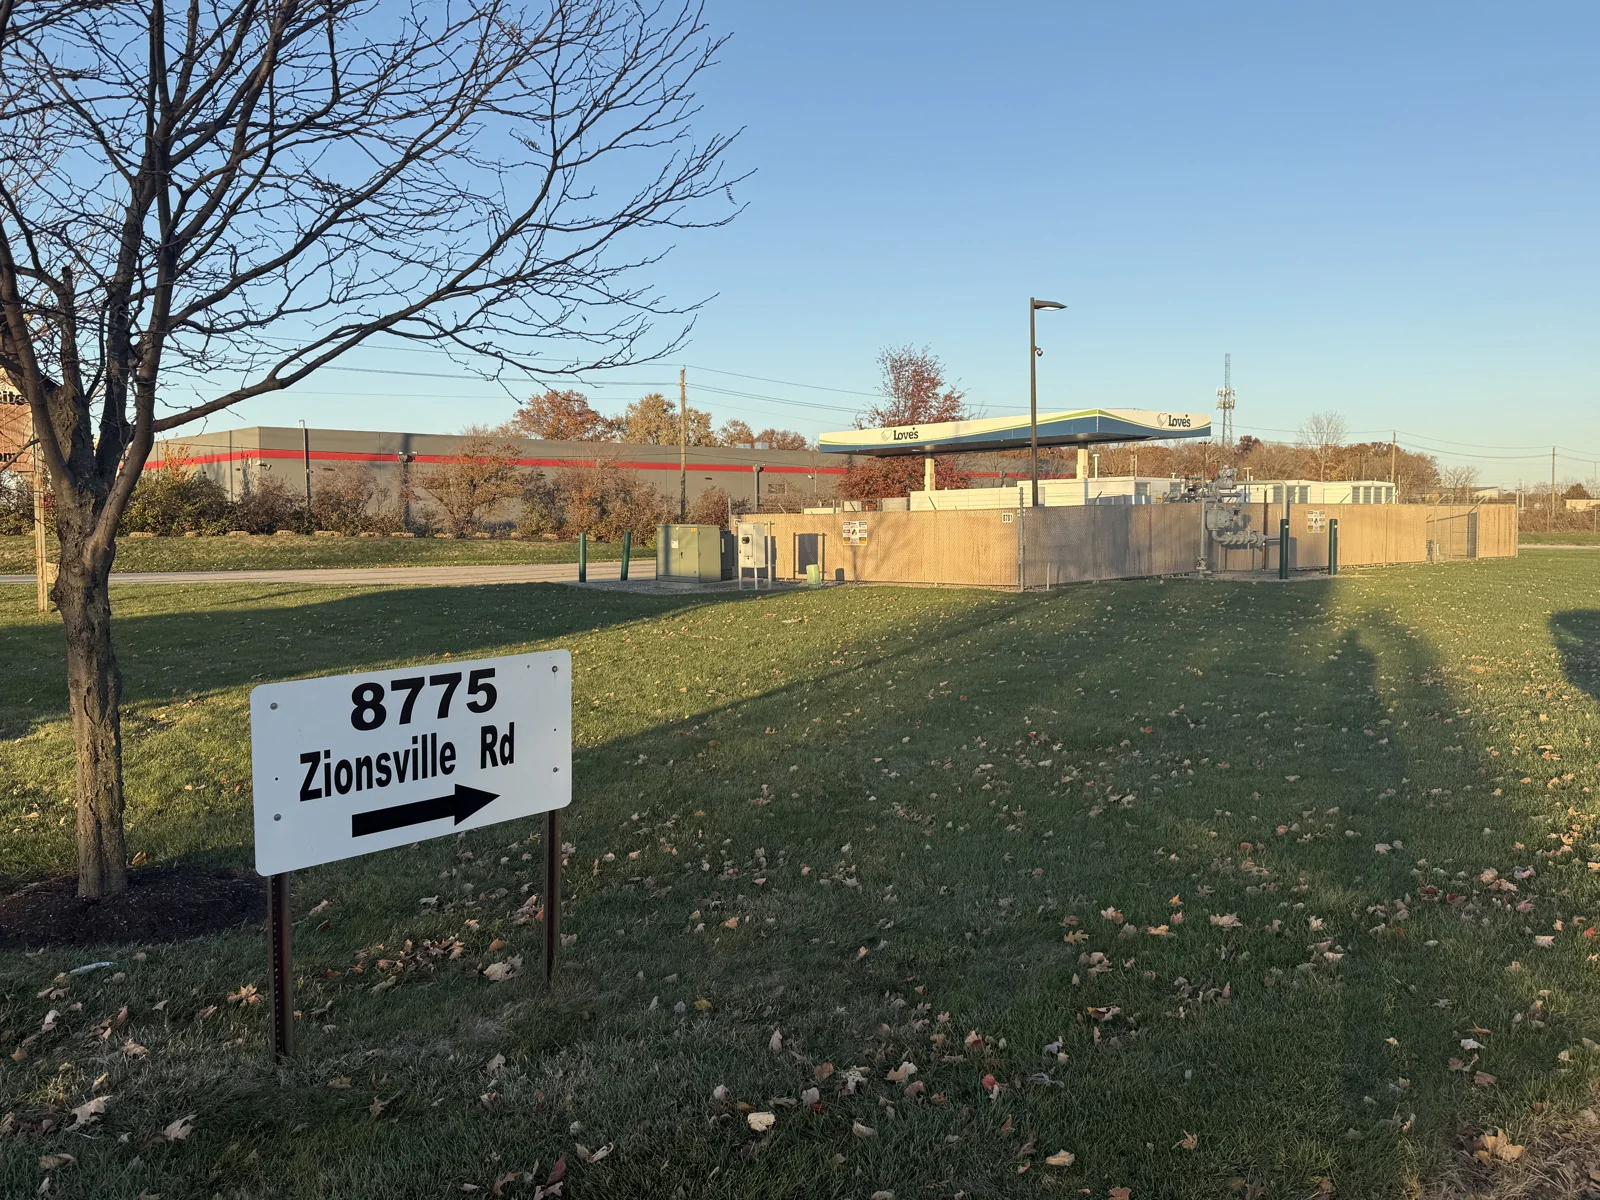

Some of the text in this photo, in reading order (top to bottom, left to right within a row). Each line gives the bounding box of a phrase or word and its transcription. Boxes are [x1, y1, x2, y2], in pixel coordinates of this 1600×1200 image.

[0, 391, 26, 405] ite
[1168, 414, 1191, 428] Love's
[893, 427, 919, 441] Love's
[350, 667, 498, 731] 8775
[300, 722, 515, 802] Zionsville Rd
